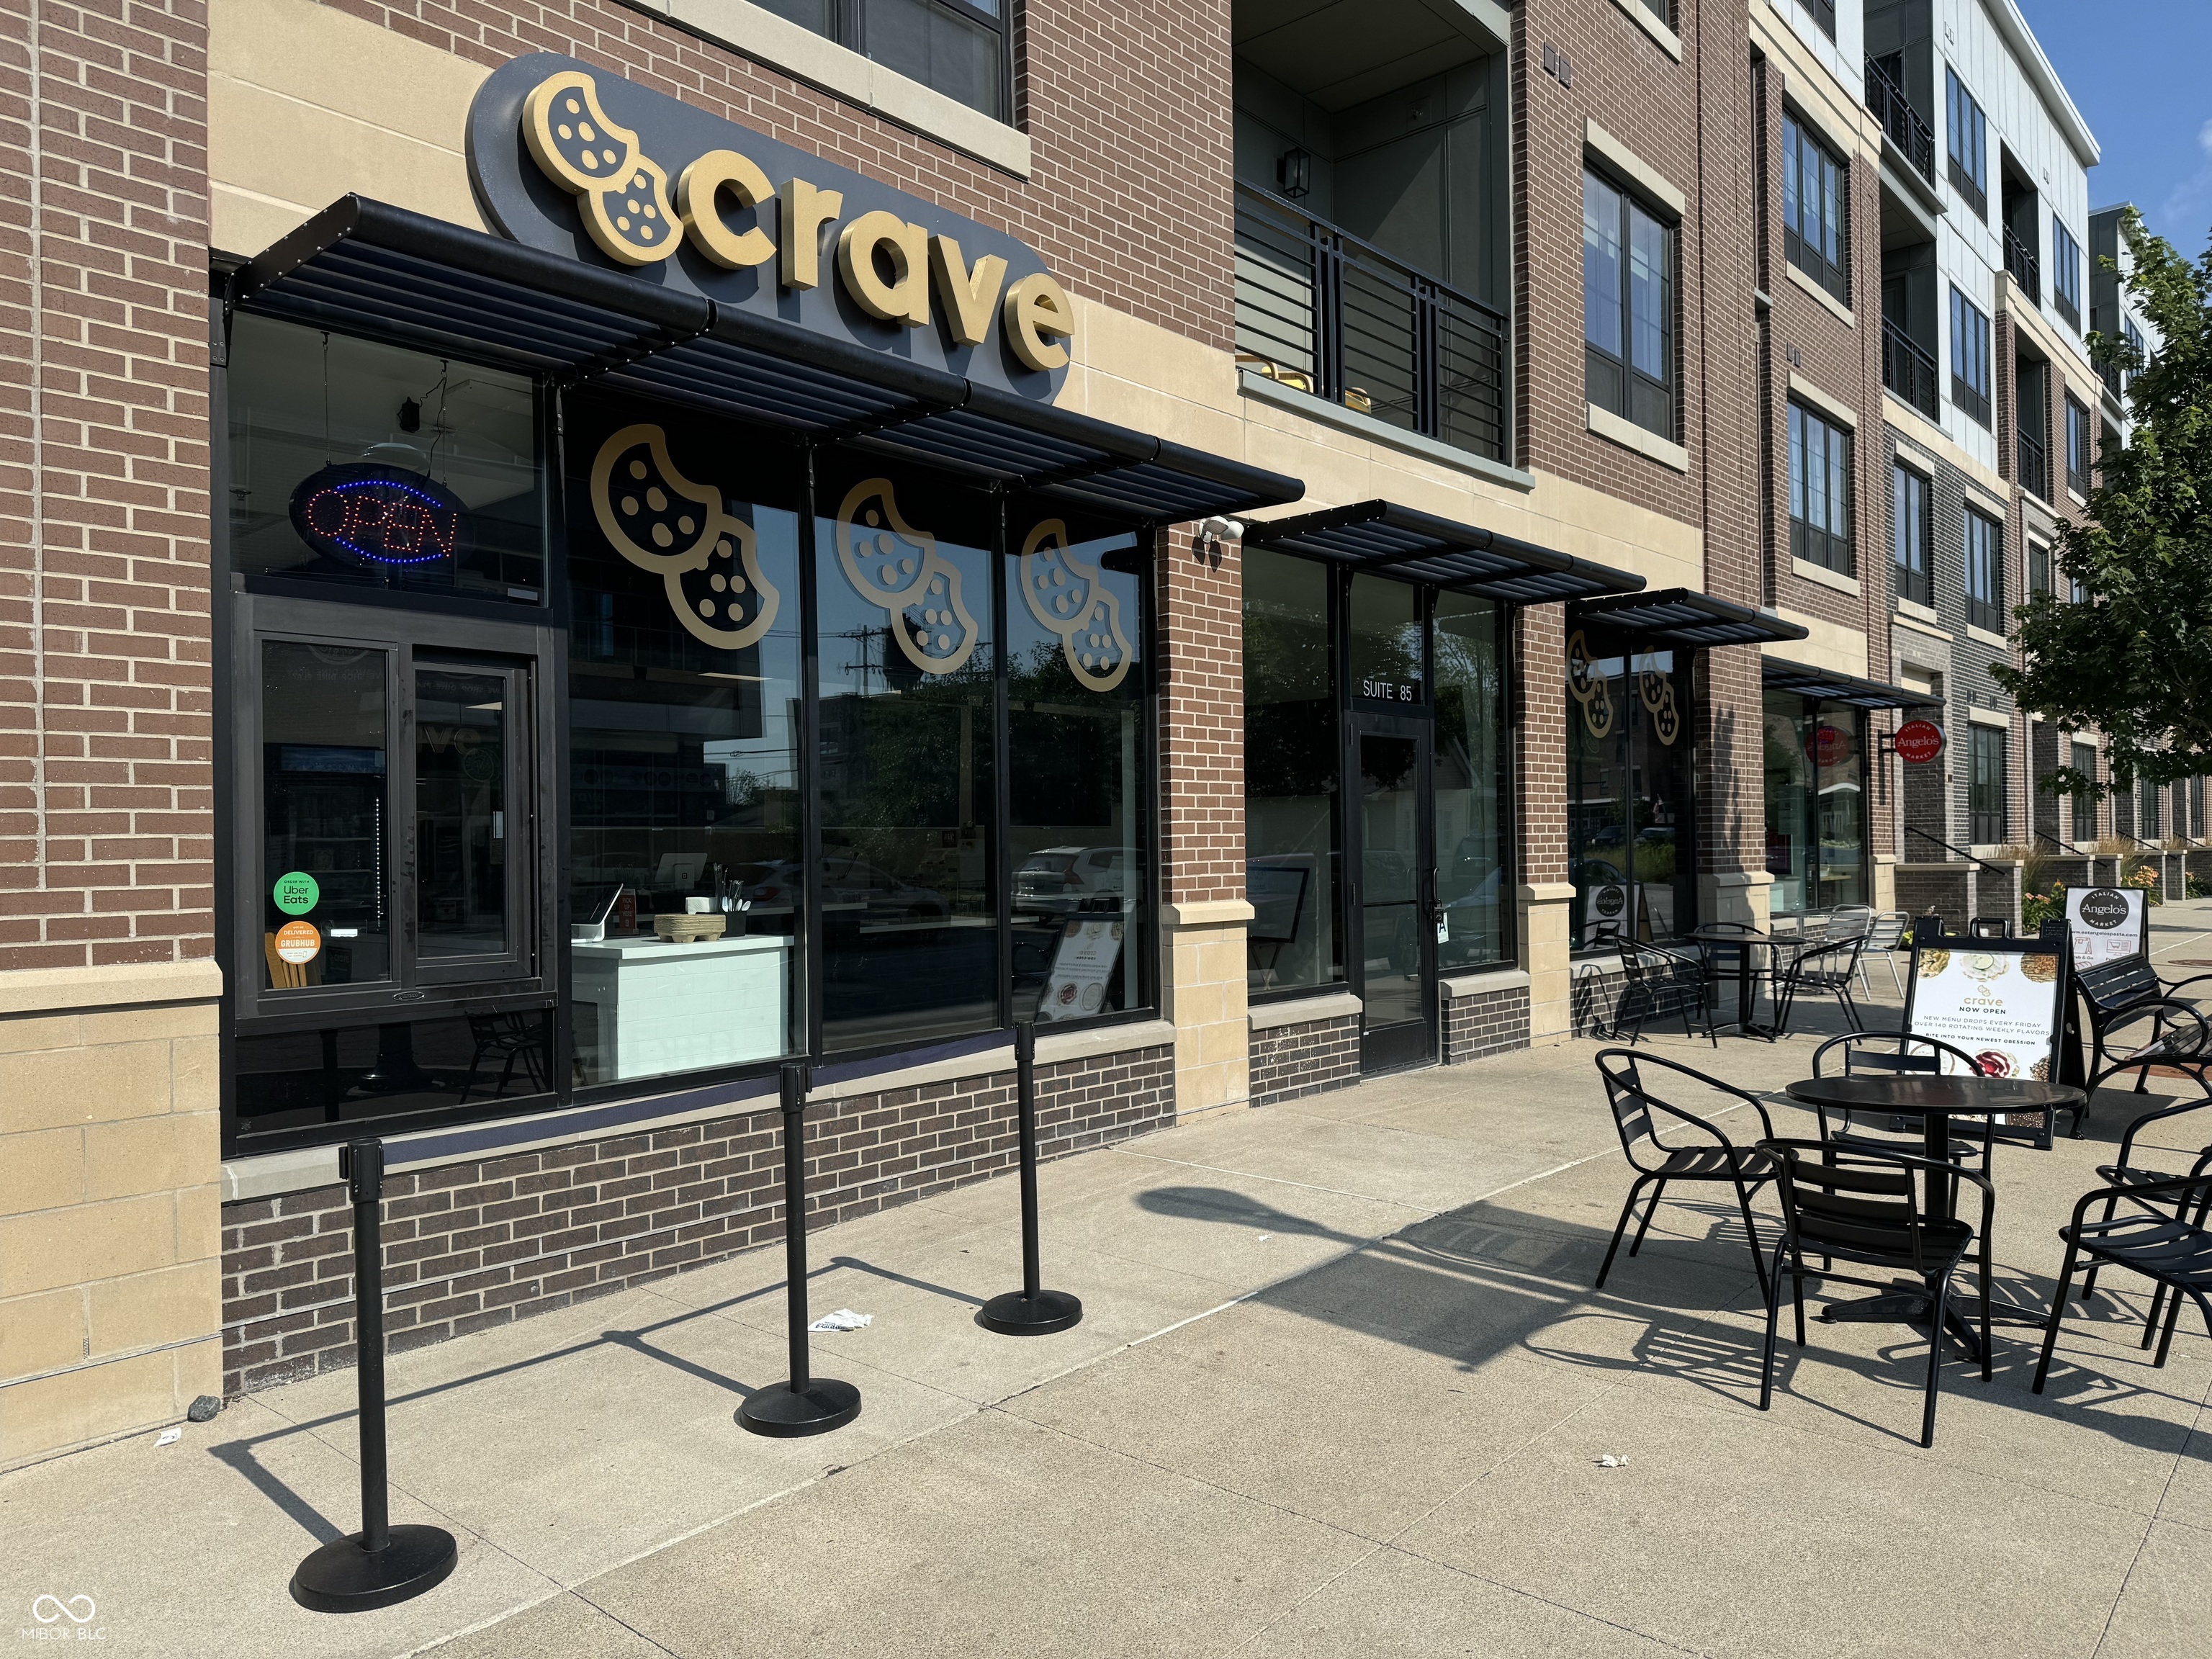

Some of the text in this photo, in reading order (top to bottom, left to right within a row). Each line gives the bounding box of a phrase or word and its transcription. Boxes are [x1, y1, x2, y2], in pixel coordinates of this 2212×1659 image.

[678, 148, 1075, 372] crave
[307, 488, 457, 558] OPEN
[1363, 680, 1412, 701] SUITE 85
[1905, 724, 1931, 732] ITALIAN
[1897, 735, 1939, 748] Angelo's
[1905, 751, 1931, 760] MARKET
[284, 895, 309, 904] Eats
[2091, 891, 2119, 900] ITALIAN
[2082, 903, 2126, 915] Angelo's
[1964, 997, 2003, 1006] crave
